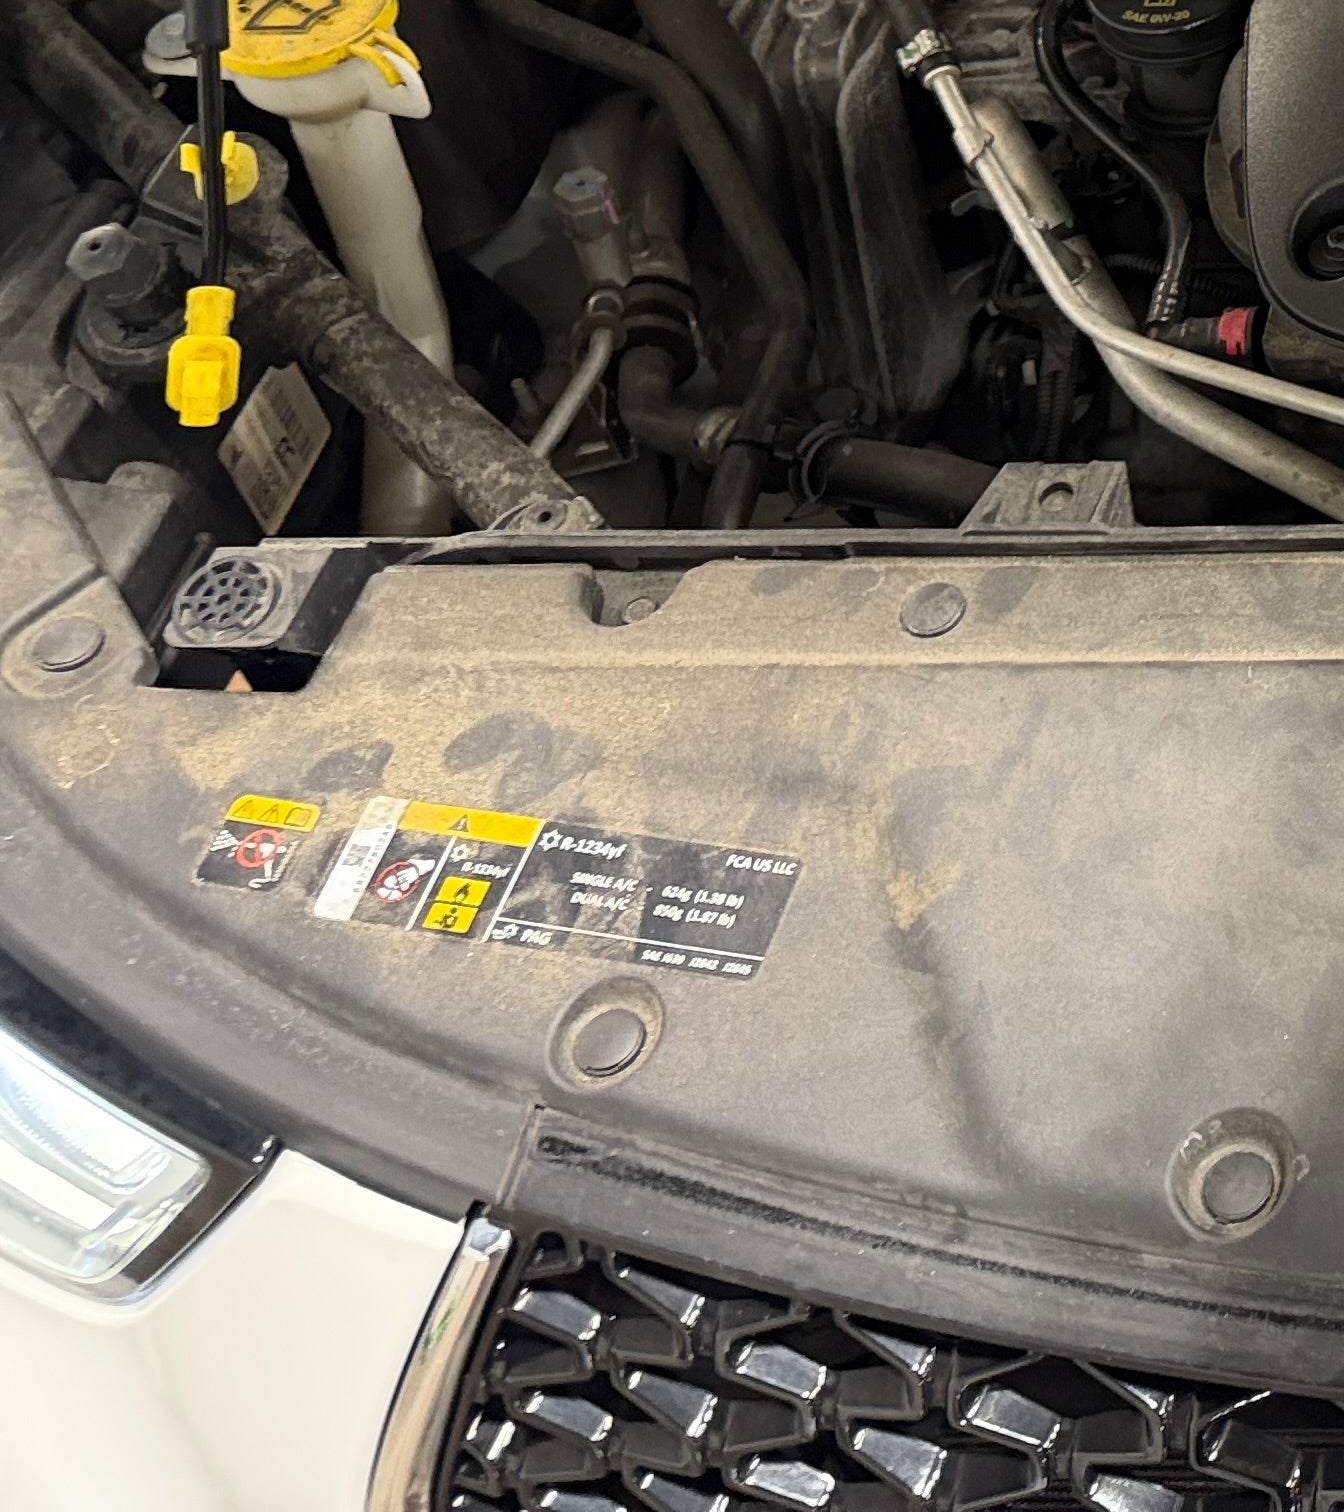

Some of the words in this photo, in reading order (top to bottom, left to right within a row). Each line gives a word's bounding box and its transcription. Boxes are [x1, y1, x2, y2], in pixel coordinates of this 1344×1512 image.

[1121, 9, 1149, 23] SAE
[1149, 9, 1191, 24] 0W-20
[560, 836, 628, 860] R-1234yf
[725, 854, 753, 870] FCA
[752, 857, 774, 873] US
[771, 860, 798, 876] LLC
[569, 871, 616, 889] SINGLE
[611, 877, 640, 893] A/C
[661, 885, 694, 903] 624g
[569, 891, 605, 908] DUAL
[604, 896, 631, 912] A/C
[519, 928, 553, 946] PAG
